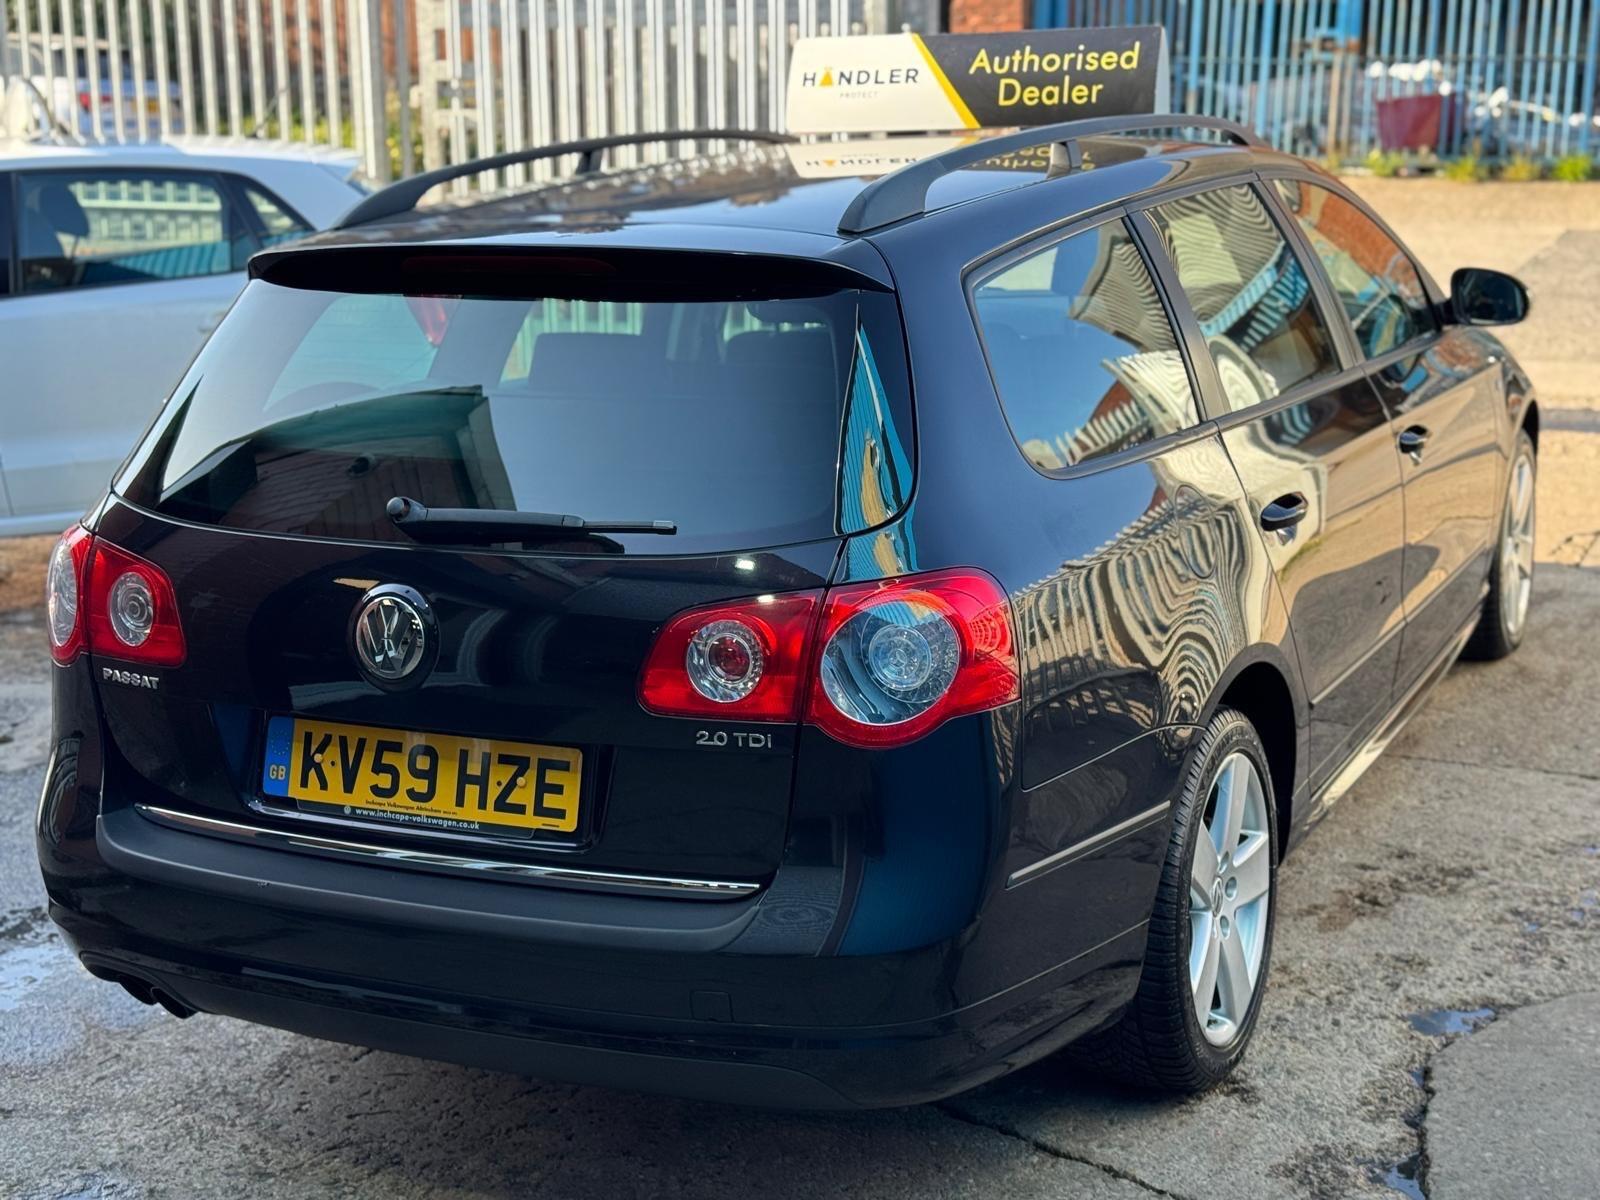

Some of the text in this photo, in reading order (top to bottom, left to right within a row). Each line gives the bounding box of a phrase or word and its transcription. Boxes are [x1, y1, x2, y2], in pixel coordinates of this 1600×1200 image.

[969, 41, 1140, 74] Authorised
[998, 75, 1104, 106] Dealer
[102, 667, 159, 689] PASSAT
[269, 764, 287, 780] GB
[300, 731, 571, 820] KV59 HZE
[355, 808, 480, 829] www.inchcape-volkswagen.co.uk
